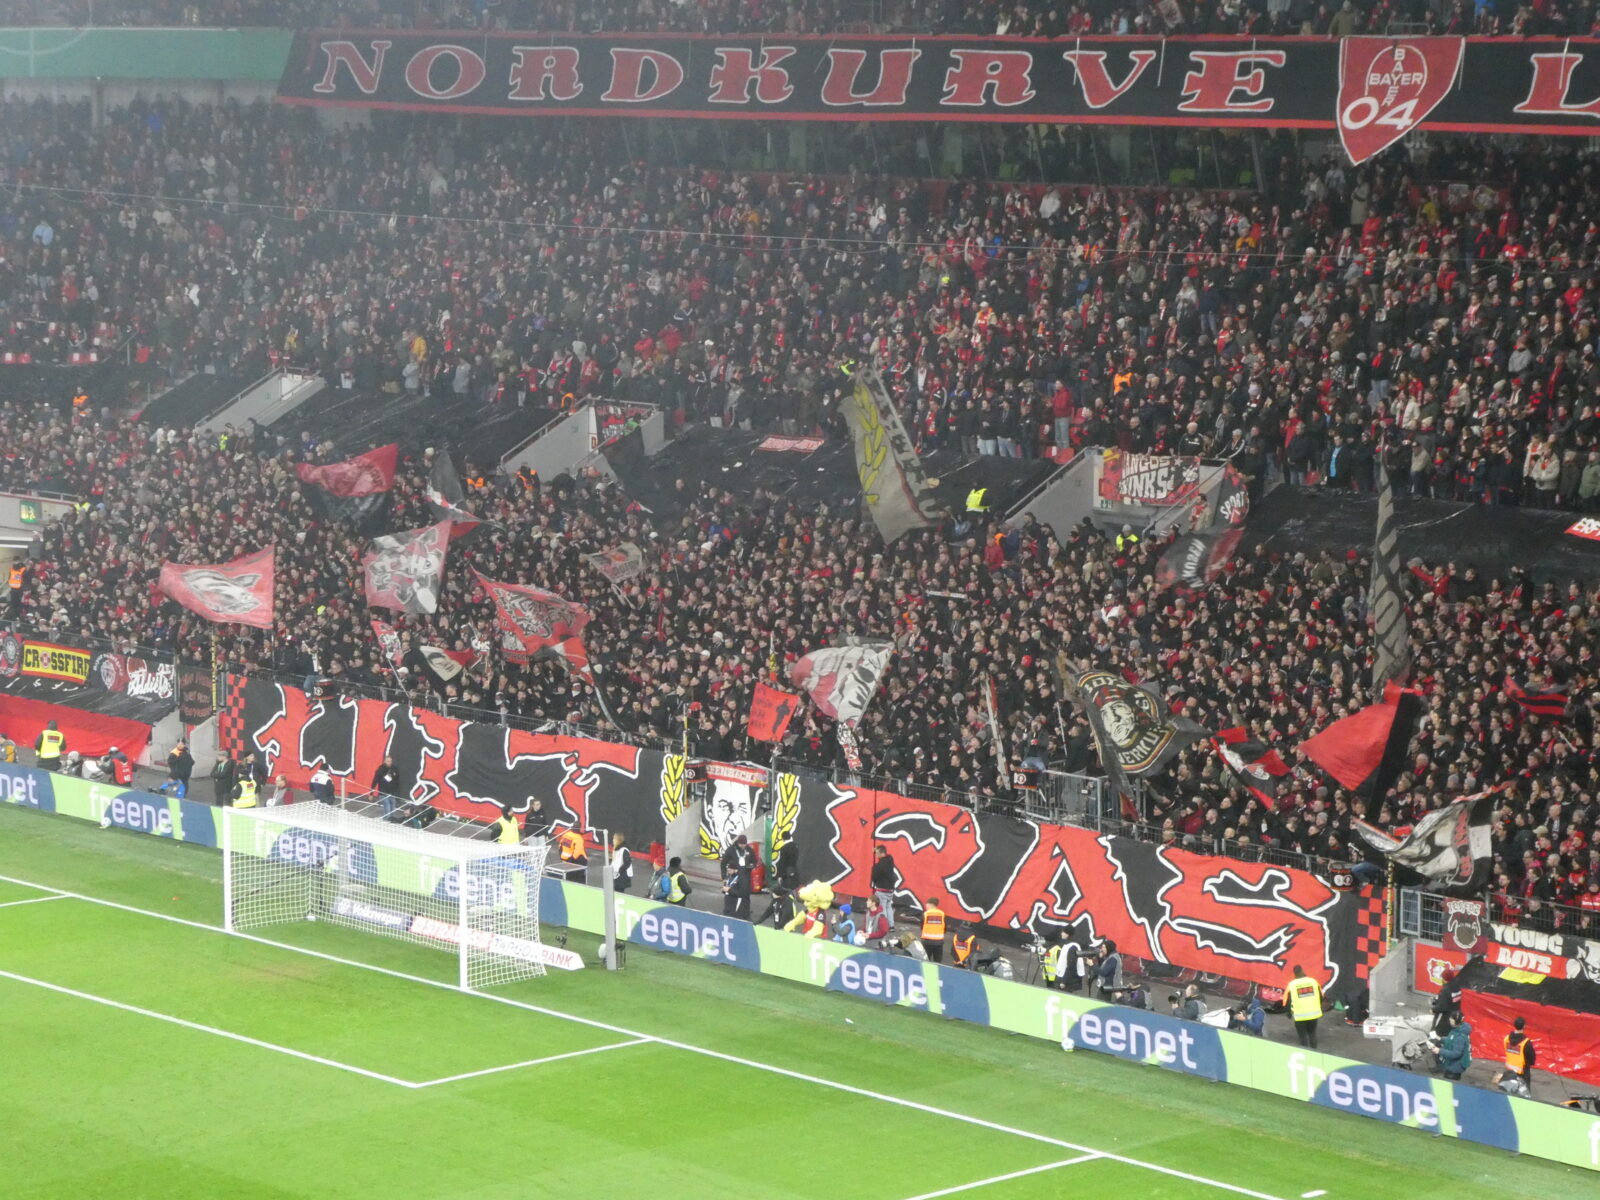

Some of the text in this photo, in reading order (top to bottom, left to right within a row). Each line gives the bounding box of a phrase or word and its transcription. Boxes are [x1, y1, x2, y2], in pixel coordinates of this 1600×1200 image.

[313, 40, 1286, 112] NORDKURVE
[1368, 72, 1425, 87] BAYER
[614, 898, 738, 962] freenet
[1489, 922, 1564, 956] YOUNG
[1496, 946, 1552, 974] BOYS
[1045, 996, 1197, 1070] freenet
